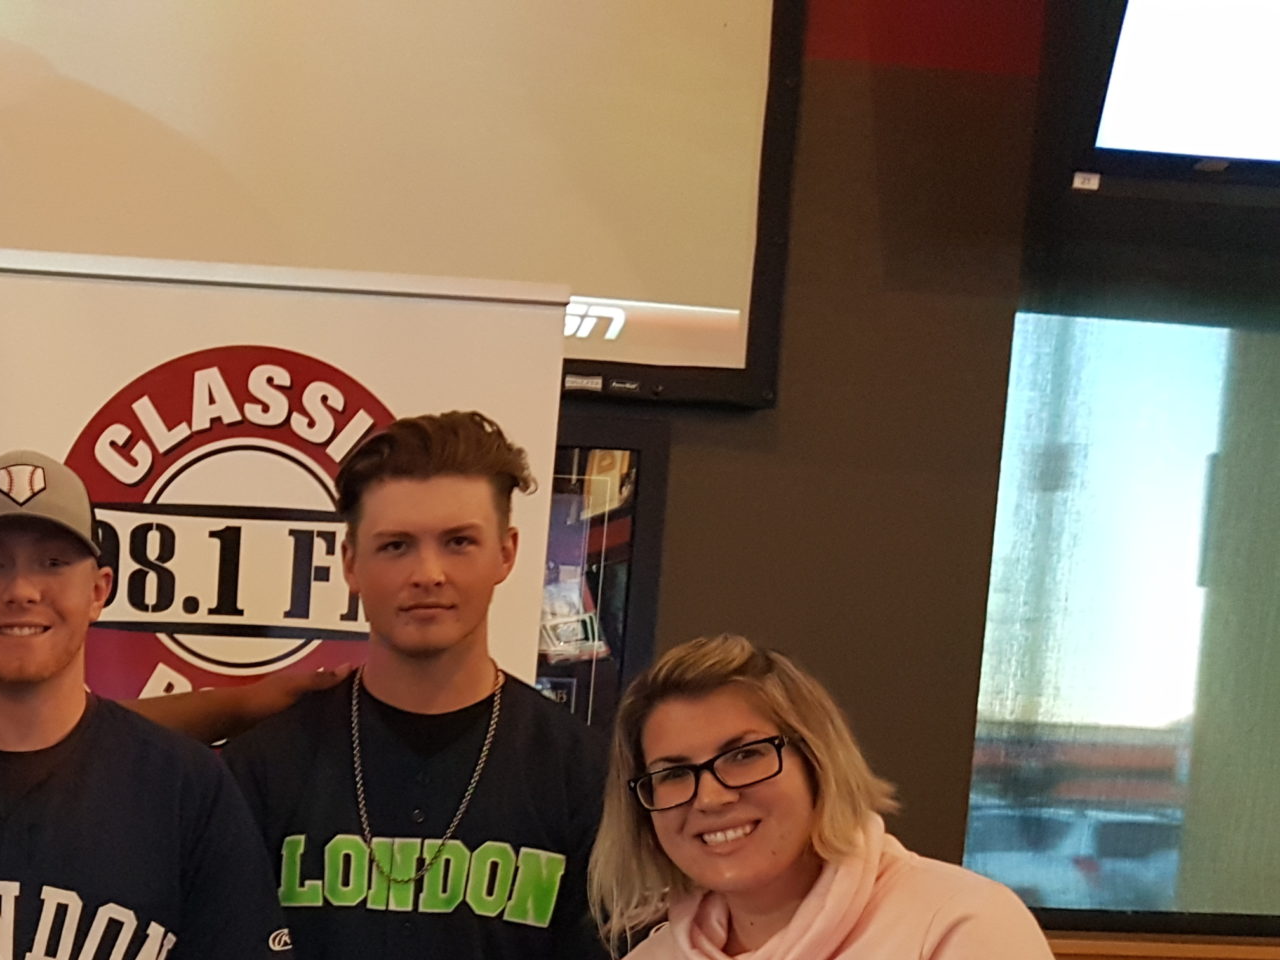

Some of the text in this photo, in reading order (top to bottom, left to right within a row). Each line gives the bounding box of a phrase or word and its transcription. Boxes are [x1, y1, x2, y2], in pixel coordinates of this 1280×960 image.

[94, 363, 375, 487] CLASSI
[283, 528, 370, 623] F
[278, 833, 567, 928] LONDON
